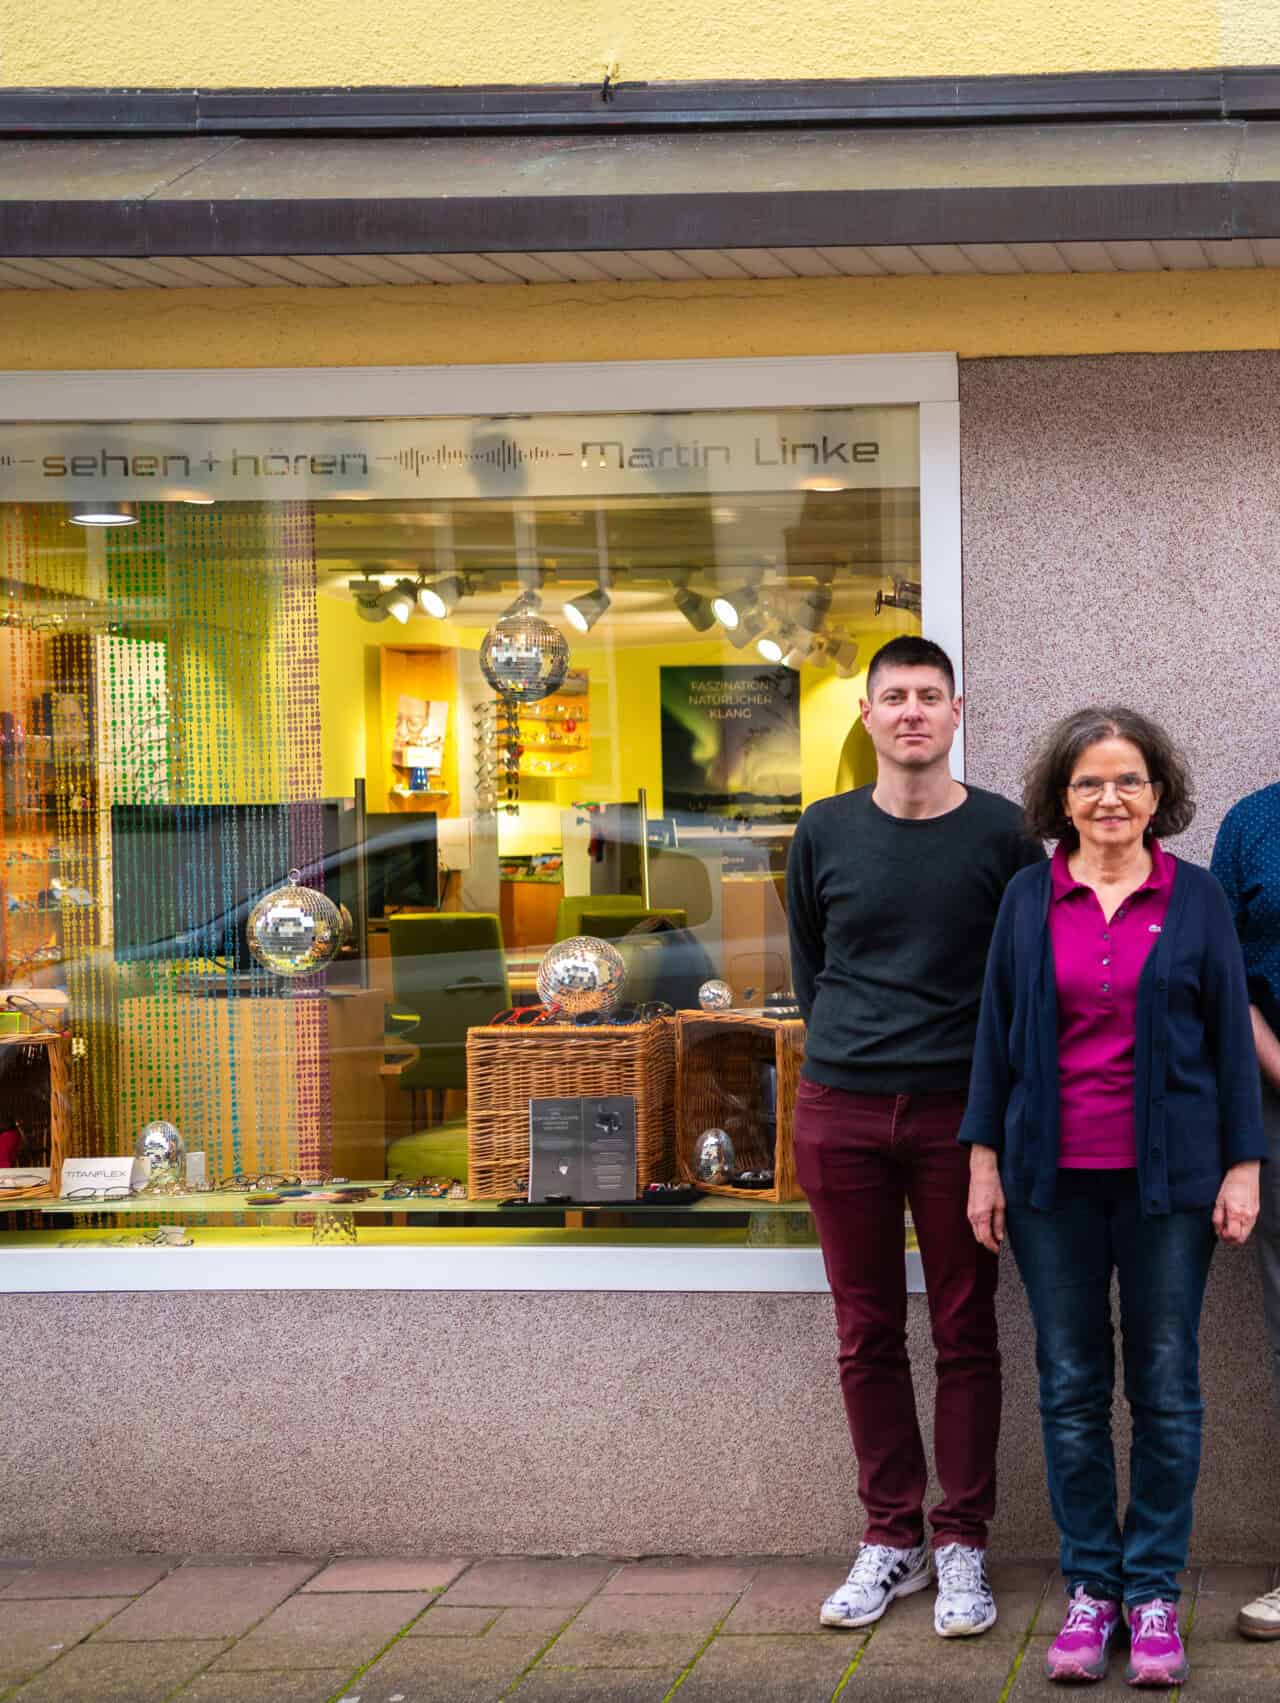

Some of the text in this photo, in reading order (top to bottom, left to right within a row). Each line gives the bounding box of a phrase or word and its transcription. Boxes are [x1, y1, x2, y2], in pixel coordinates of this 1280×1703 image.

[42, 448, 191, 477] sehen
[580, 440, 731, 469] Martin
[754, 436, 880, 466] Linke
[690, 680, 770, 692] FASZINATION
[708, 708, 753, 719] KLANG
[64, 1170, 128, 1178] TITANFLEX
